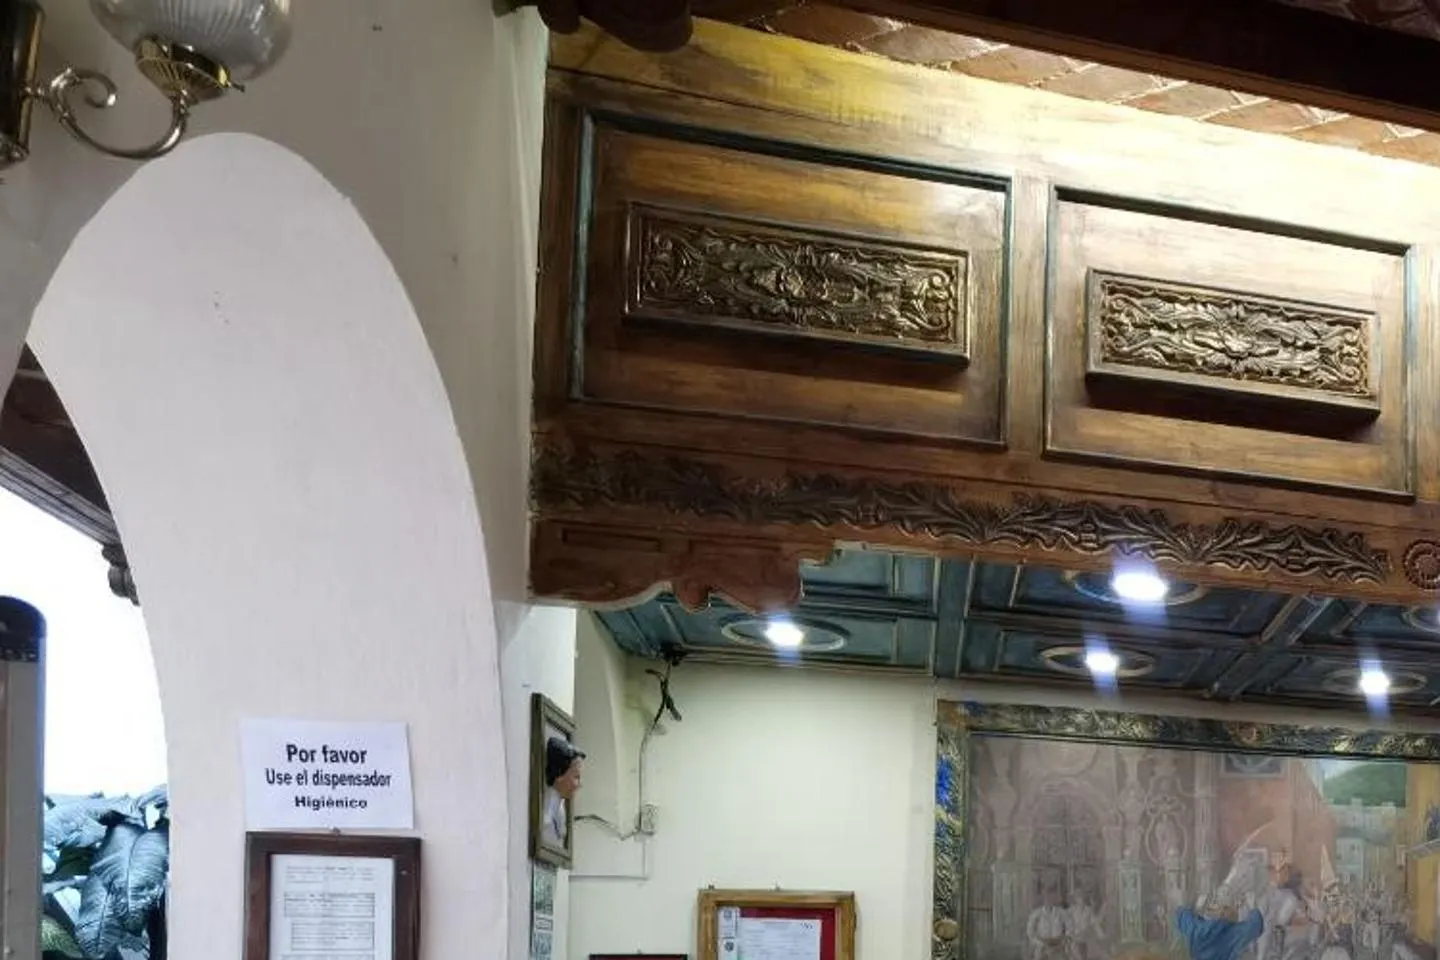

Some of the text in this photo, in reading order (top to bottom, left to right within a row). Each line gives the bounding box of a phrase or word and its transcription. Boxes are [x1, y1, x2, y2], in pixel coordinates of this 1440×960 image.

[286, 743, 368, 764] Por favor
[264, 767, 392, 790] Use el dispensador
